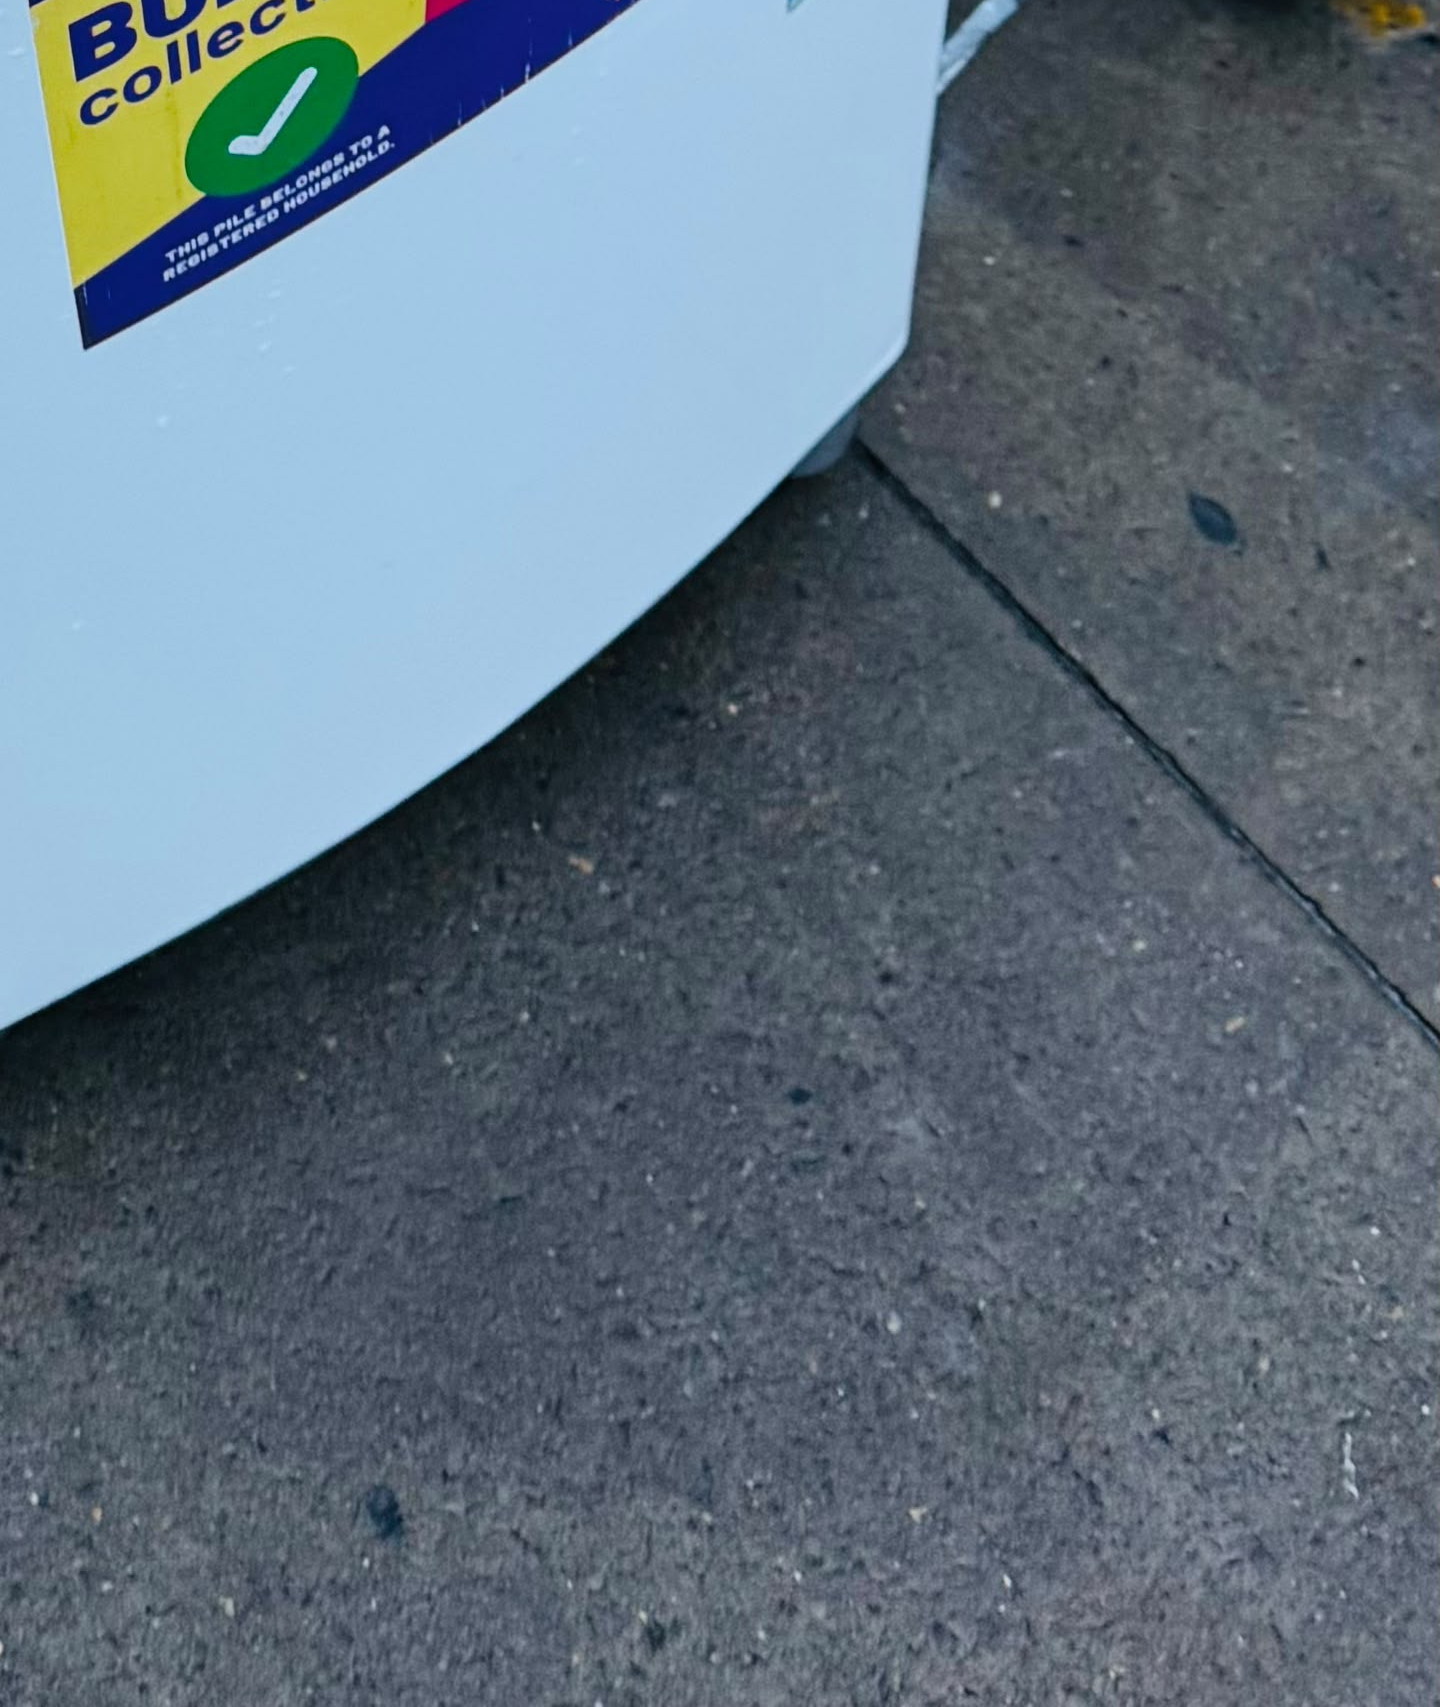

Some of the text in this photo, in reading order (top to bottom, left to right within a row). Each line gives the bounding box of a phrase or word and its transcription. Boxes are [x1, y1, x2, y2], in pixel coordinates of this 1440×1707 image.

[163, 140, 395, 282] REGISTERED HOUSEHOLD.
[165, 125, 391, 263] THIS PILE BELONGS TO A
